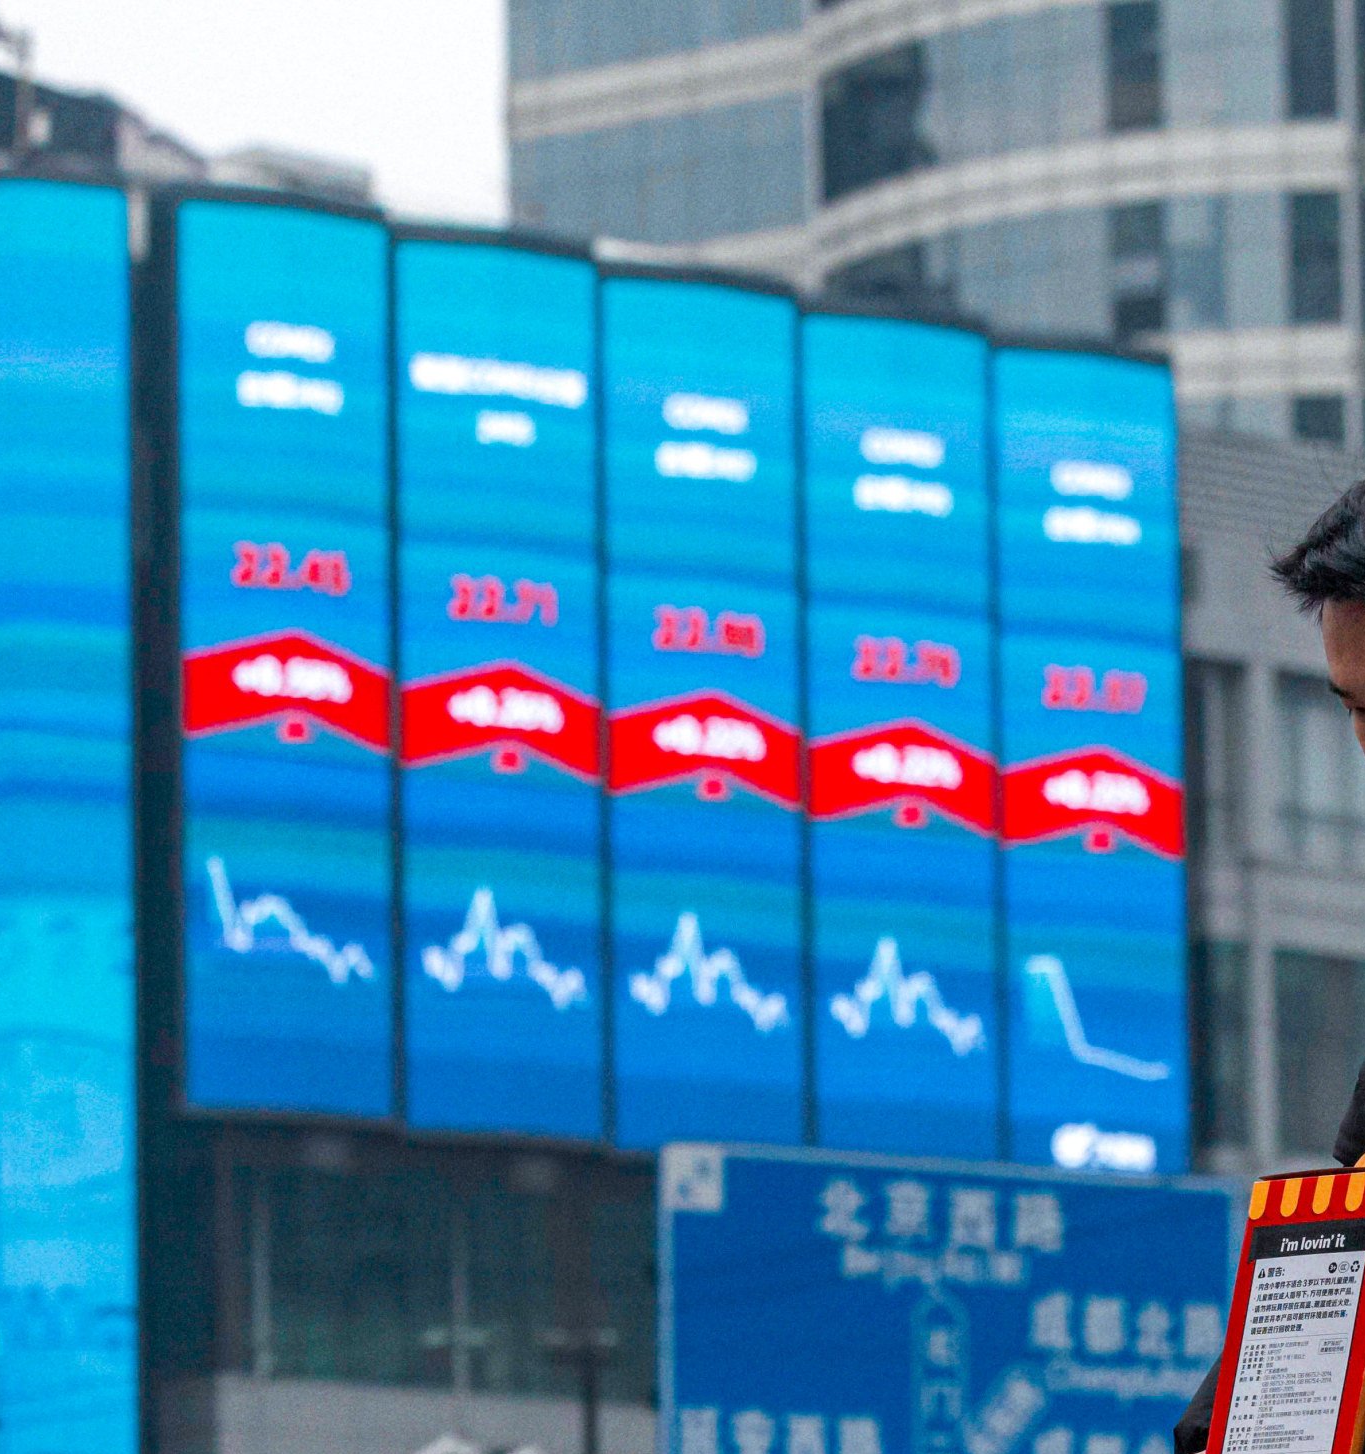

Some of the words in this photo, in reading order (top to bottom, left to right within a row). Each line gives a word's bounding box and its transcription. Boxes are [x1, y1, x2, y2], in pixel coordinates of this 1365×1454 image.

[1280, 1237, 1299, 1253] i'm
[1300, 1234, 1335, 1251] lovin'
[1335, 1233, 1346, 1248] it
